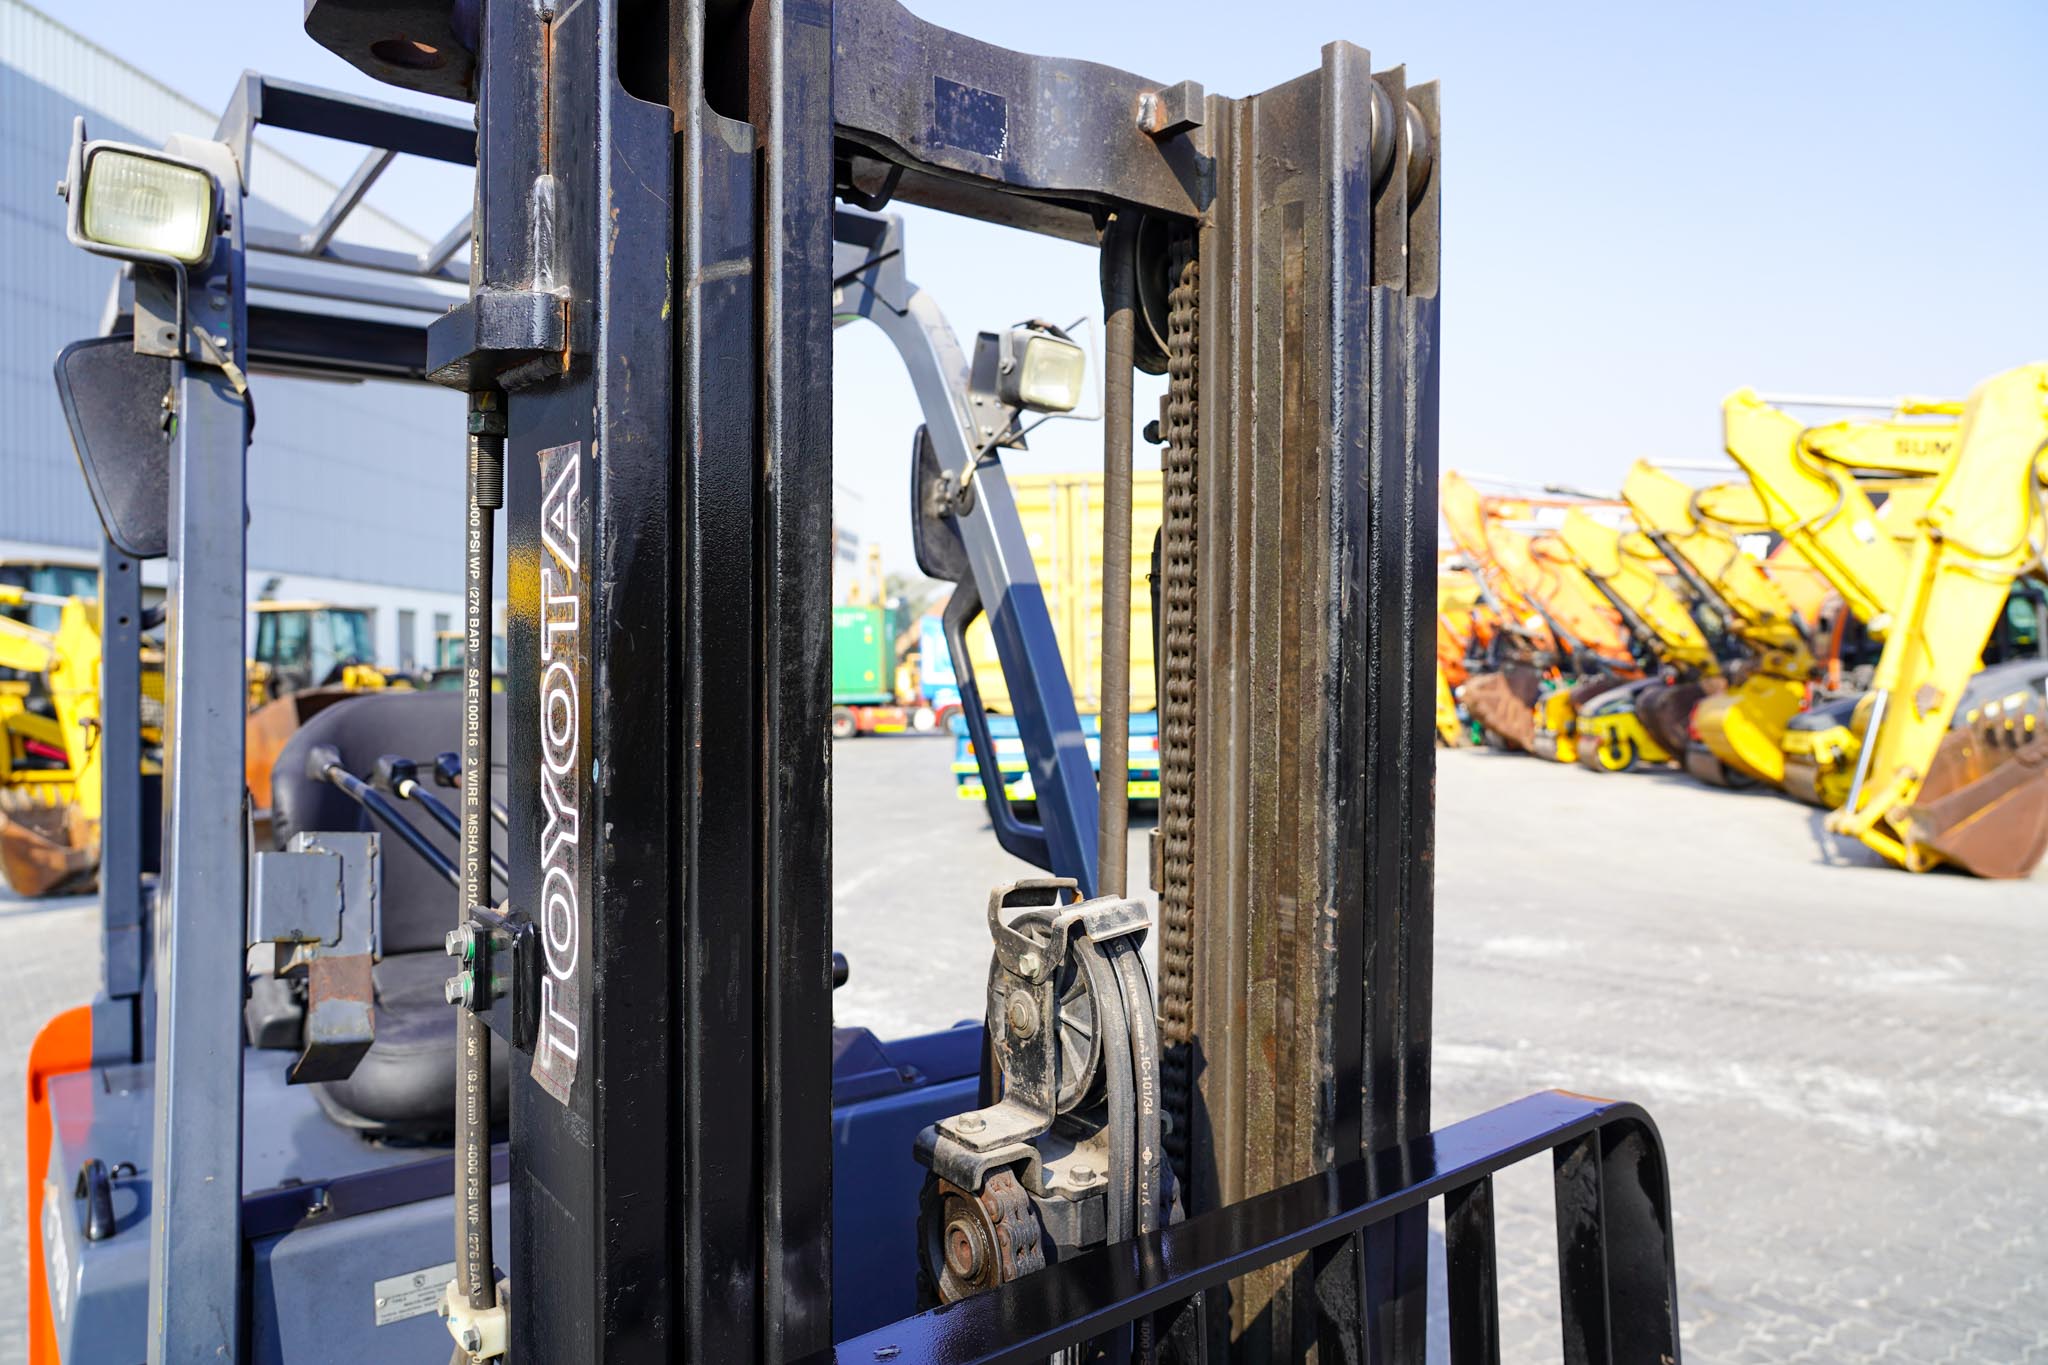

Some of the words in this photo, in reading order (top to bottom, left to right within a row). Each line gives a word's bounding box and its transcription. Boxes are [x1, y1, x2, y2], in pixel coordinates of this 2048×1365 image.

[469, 495, 481, 527] 4000
[469, 530, 480, 553] PSI
[469, 556, 480, 580] WP
[468, 585, 480, 614] (276
[468, 618, 480, 652] BAR)
[467, 668, 479, 747] SAE100R16
[467, 757, 478, 766] 2
[539, 452, 579, 1069] TOYOTA
[467, 769, 478, 806] WIRE
[467, 813, 478, 854] MSHA
[467, 1036, 478, 1061] 3/8"
[467, 1069, 479, 1093] (9.5
[1141, 1056, 1153, 1115] IC-101/34
[467, 1096, 479, 1126] mm)
[467, 1143, 479, 1175] 4000
[467, 1178, 479, 1201] PSI
[468, 1203, 479, 1225] WP
[468, 1231, 480, 1259] (276
